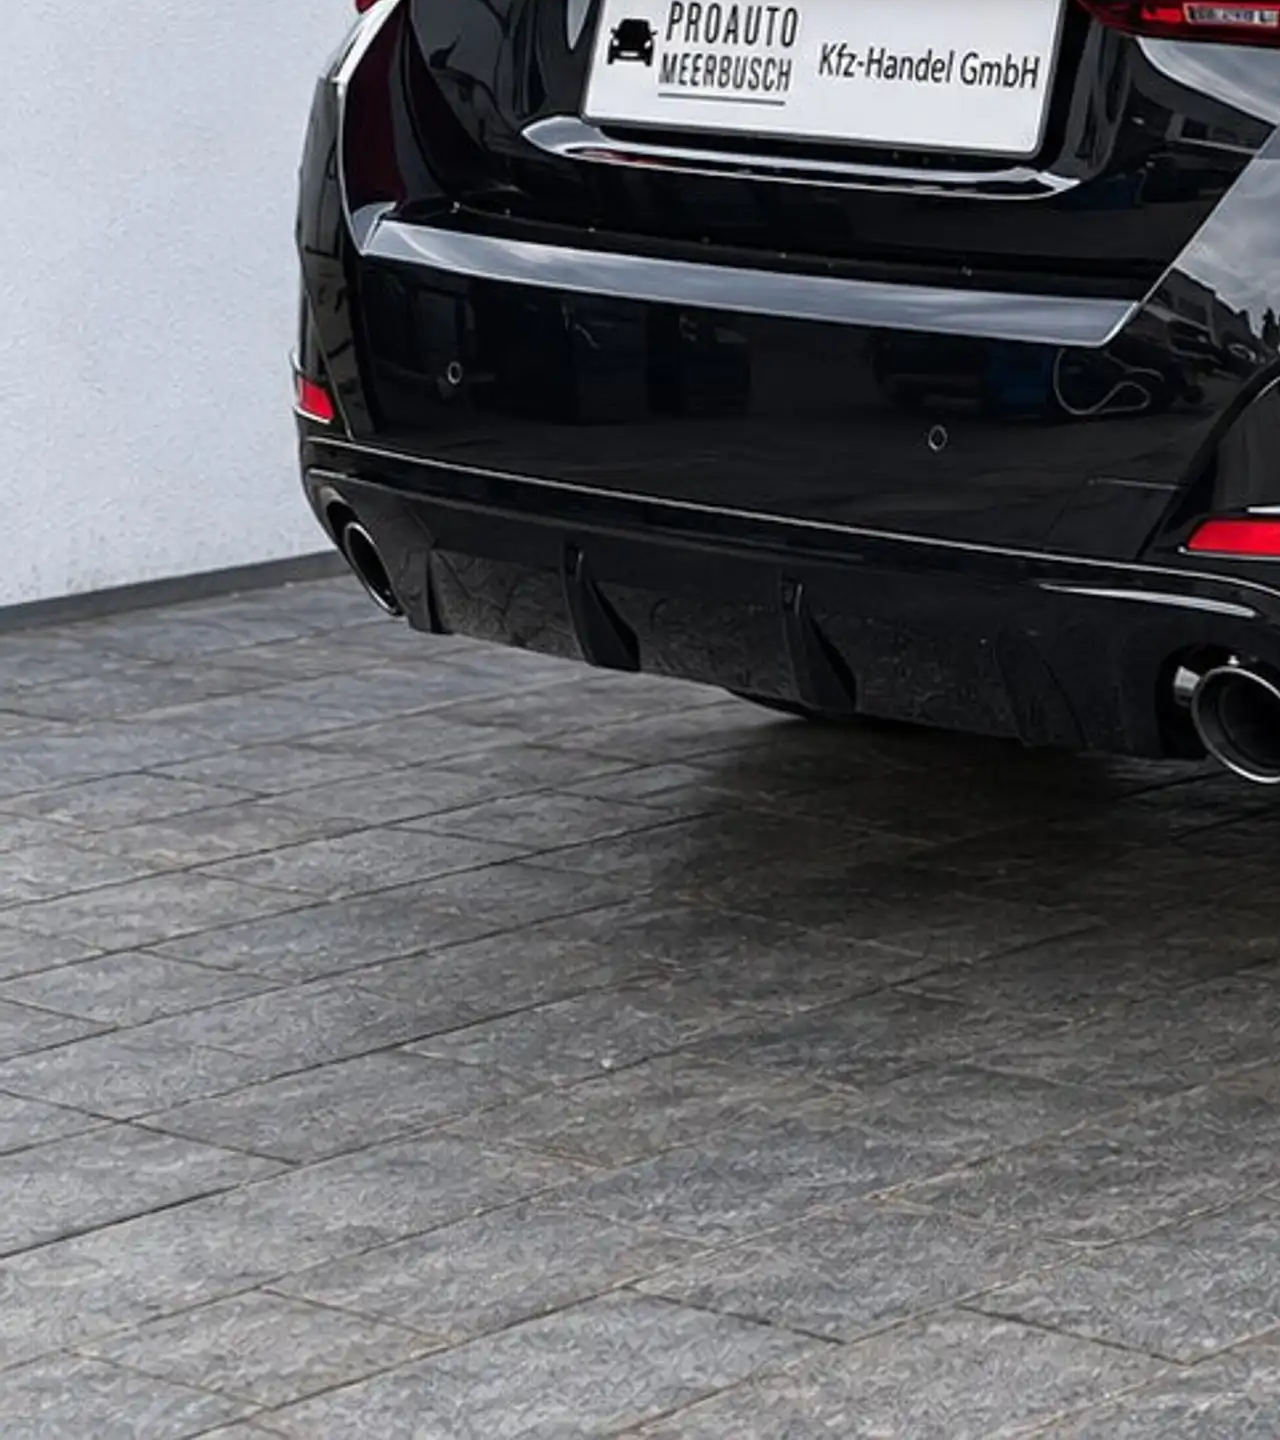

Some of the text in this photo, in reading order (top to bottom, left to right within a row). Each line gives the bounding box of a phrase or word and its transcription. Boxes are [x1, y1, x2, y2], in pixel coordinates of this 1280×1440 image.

[664, 0, 799, 48] PROAUTO
[657, 51, 793, 93] MEERBUSCH
[818, 42, 1041, 89] Kfz-Handel GmbH
